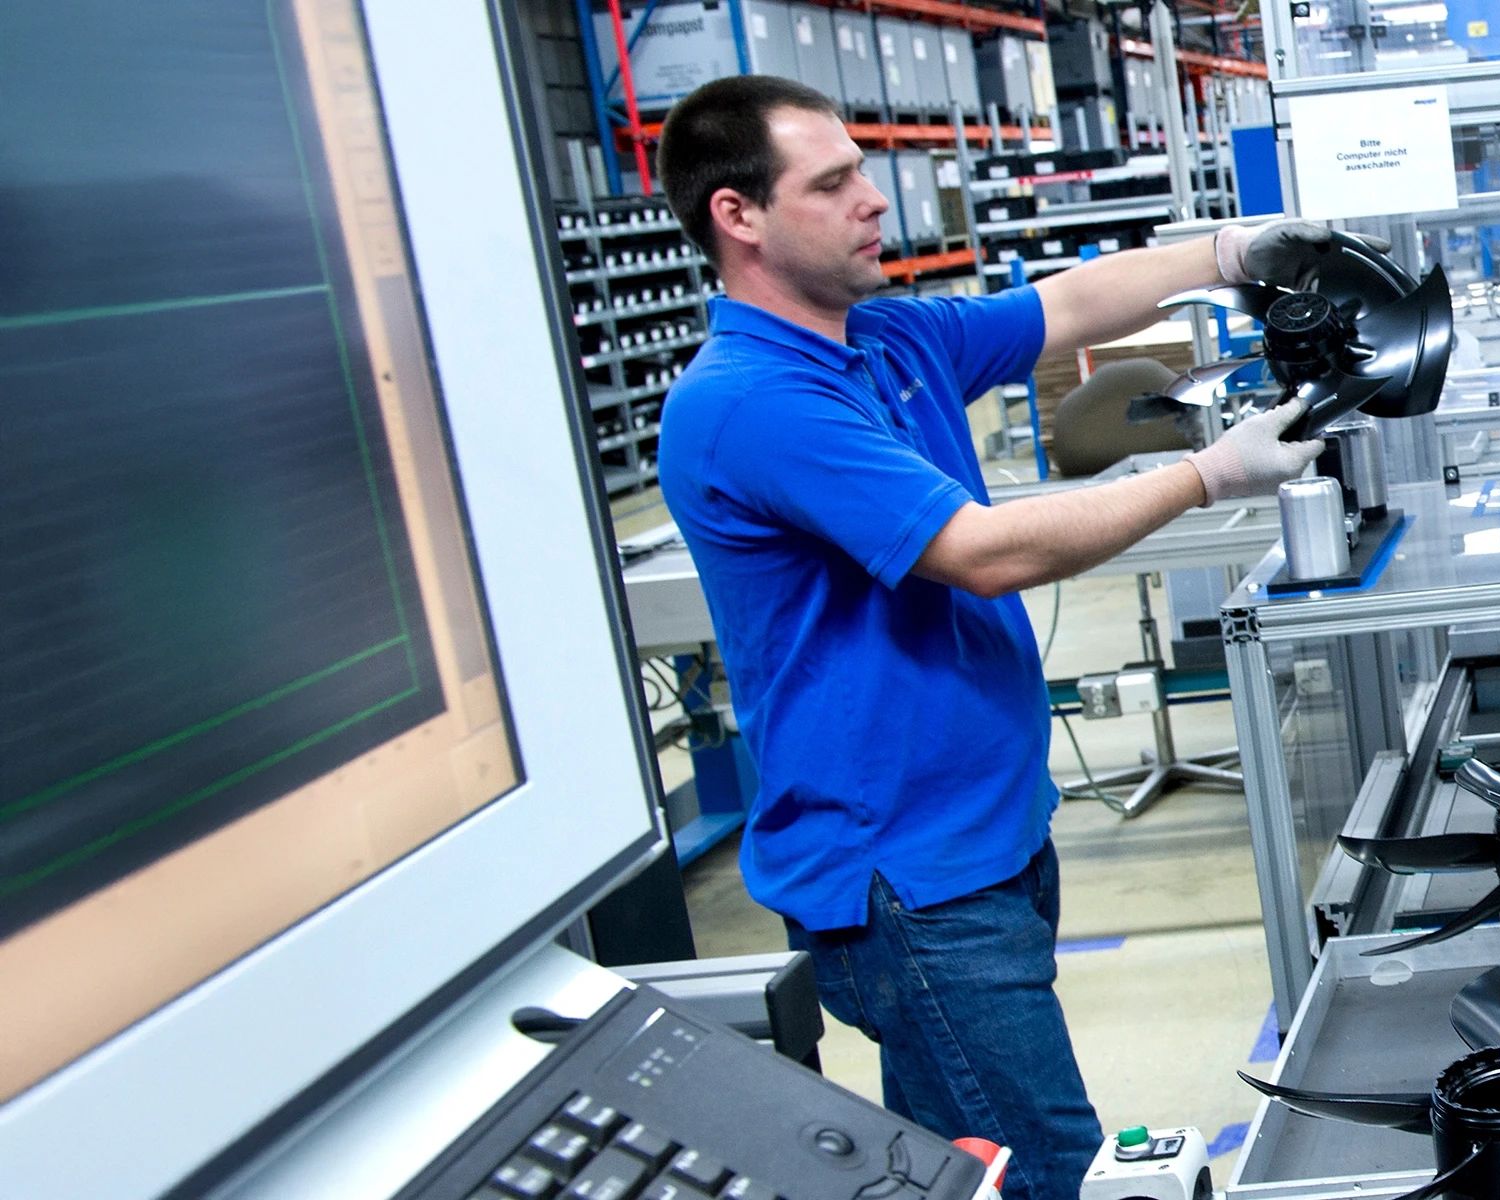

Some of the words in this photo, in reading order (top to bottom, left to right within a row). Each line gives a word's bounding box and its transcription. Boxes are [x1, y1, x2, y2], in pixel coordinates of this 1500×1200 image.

[1360, 140, 1381, 148] Bitte
[1336, 152, 1381, 161] Computer
[1384, 148, 1408, 157] nicht
[1345, 160, 1401, 171] ausschalten
